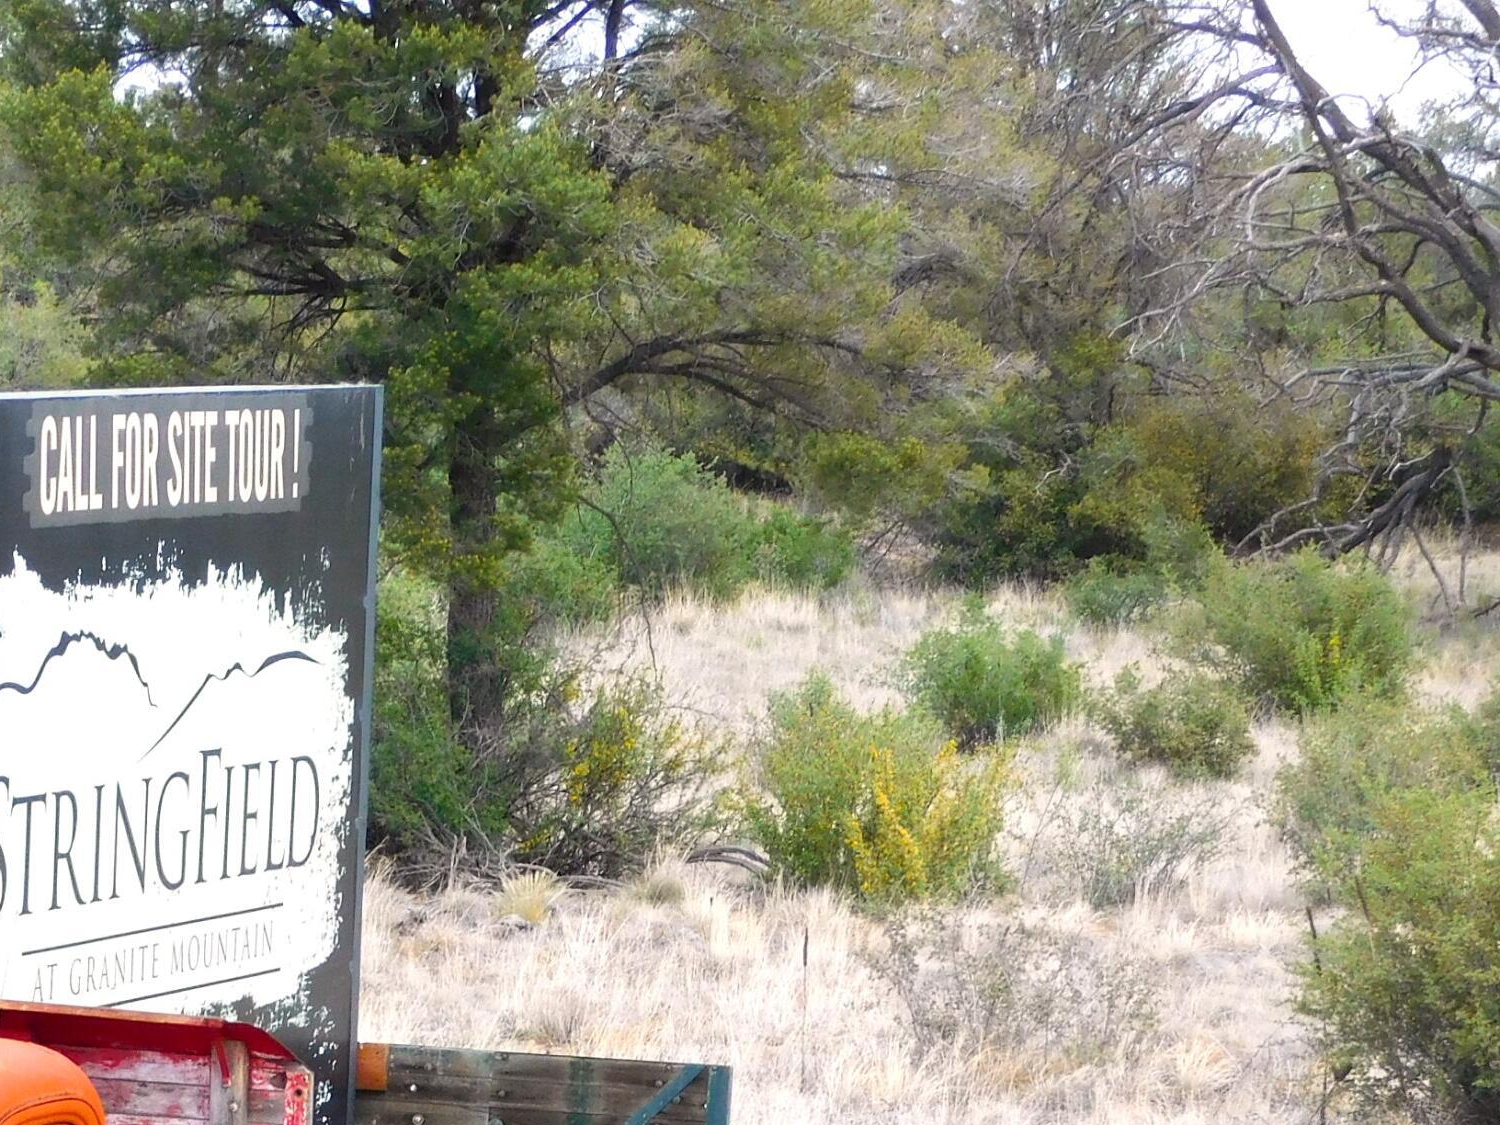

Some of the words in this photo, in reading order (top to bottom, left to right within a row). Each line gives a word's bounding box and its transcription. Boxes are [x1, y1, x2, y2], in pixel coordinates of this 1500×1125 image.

[40, 414, 103, 516] CALL
[111, 411, 159, 510] FOR
[166, 410, 219, 507] SITE
[32, 963, 58, 1002] AT
[69, 943, 160, 996] GRANITE
[170, 919, 274, 976] MOUNTAIN
